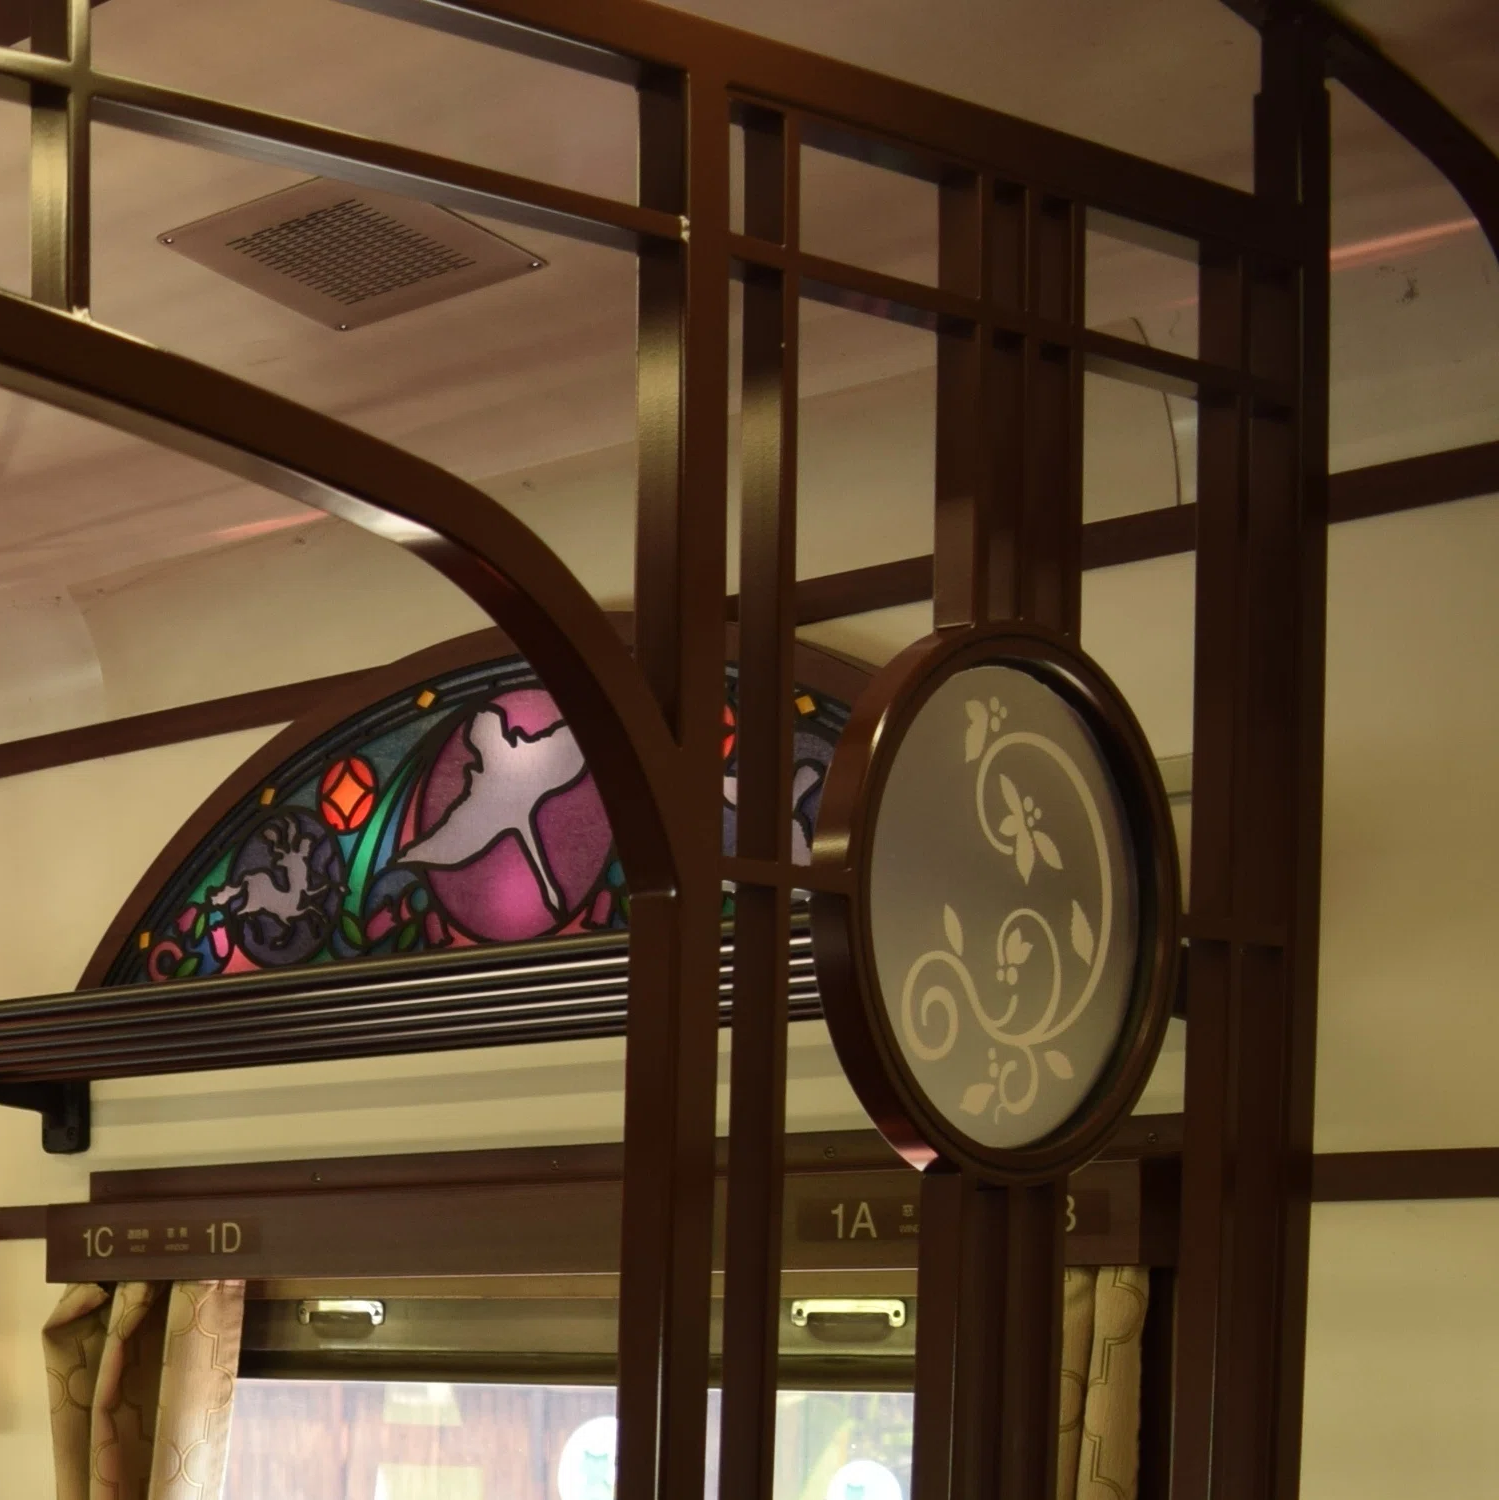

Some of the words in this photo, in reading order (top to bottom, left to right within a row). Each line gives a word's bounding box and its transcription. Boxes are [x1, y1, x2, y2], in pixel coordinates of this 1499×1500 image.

[830, 1200, 878, 1239] 1A
[82, 1226, 114, 1258] 1C
[205, 1221, 242, 1254] 1D
